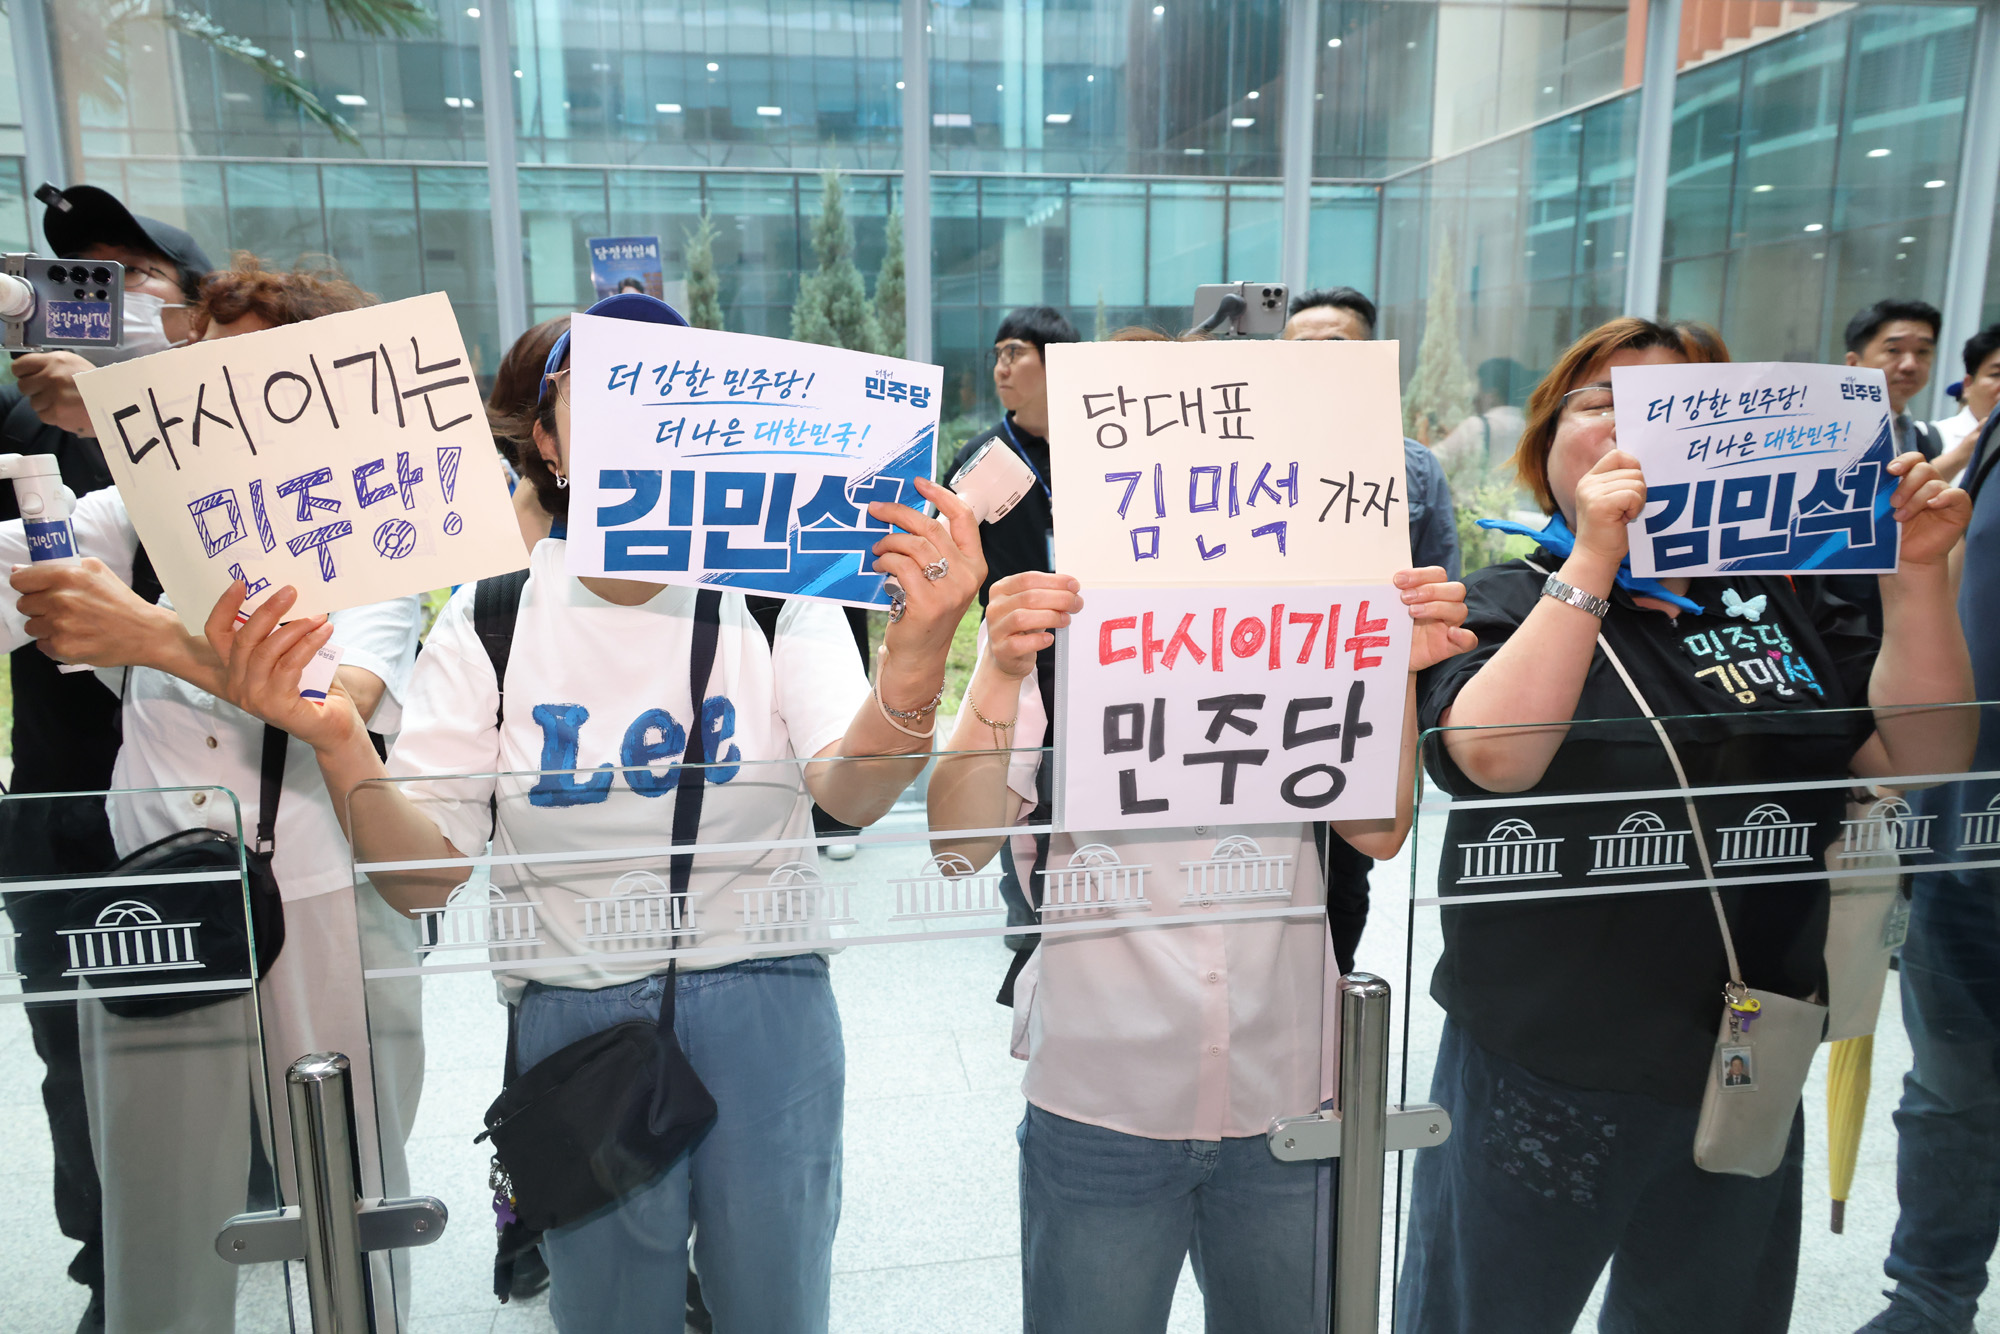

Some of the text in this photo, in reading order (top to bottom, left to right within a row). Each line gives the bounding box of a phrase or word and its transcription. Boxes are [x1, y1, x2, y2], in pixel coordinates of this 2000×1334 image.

[607, 360, 815, 400] 더 강한 민주당!
[865, 376, 931, 409] 민주당
[1647, 385, 1808, 423] 더 강한 민주당!
[1840, 383, 1882, 402] 민주당
[655, 417, 871, 453] 더 나은 대한민국!
[1082, 381, 1254, 449] 당대표
[1687, 421, 1851, 462] 더 나은 대한민국!
[188, 447, 461, 600] 민주당!
[597, 469, 902, 574] 김민석
[1318, 471, 1400, 527] 가자
[1645, 463, 1880, 573] 김민석
[1684, 623, 1793, 661] 민주당
[1694, 655, 1824, 704] 김민석
[528, 695, 741, 808] Lee
[1103, 680, 1374, 816] 민주당
